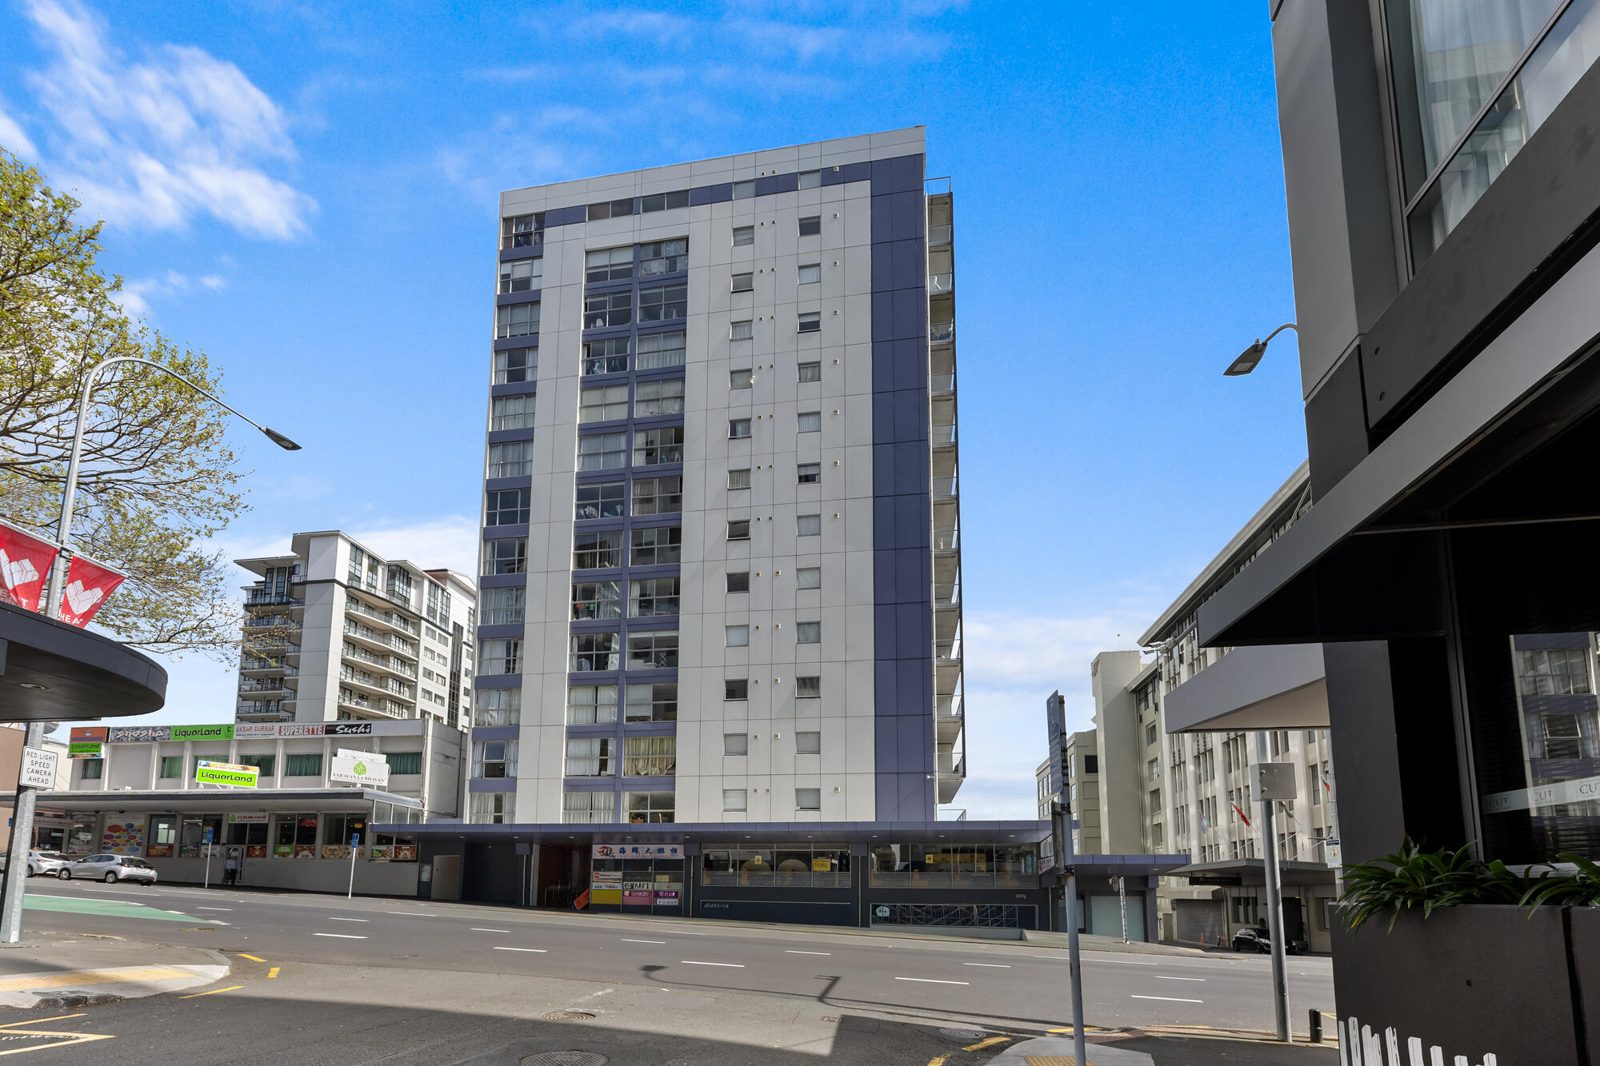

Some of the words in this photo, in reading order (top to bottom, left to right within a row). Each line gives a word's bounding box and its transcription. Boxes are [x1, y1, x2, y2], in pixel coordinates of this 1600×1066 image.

[174, 728, 222, 737] LiquorLand
[280, 725, 324, 736] SUPERETTE
[335, 724, 371, 734] Sushi
[26, 750, 38, 759] RED
[39, 753, 56, 761] LIGHT
[30, 760, 51, 769] SPEED
[26, 767, 52, 777] CAMERA
[201, 771, 253, 783] LiquorLand
[27, 776, 50, 785] AHEAD
[1534, 789, 1553, 802] CUT
